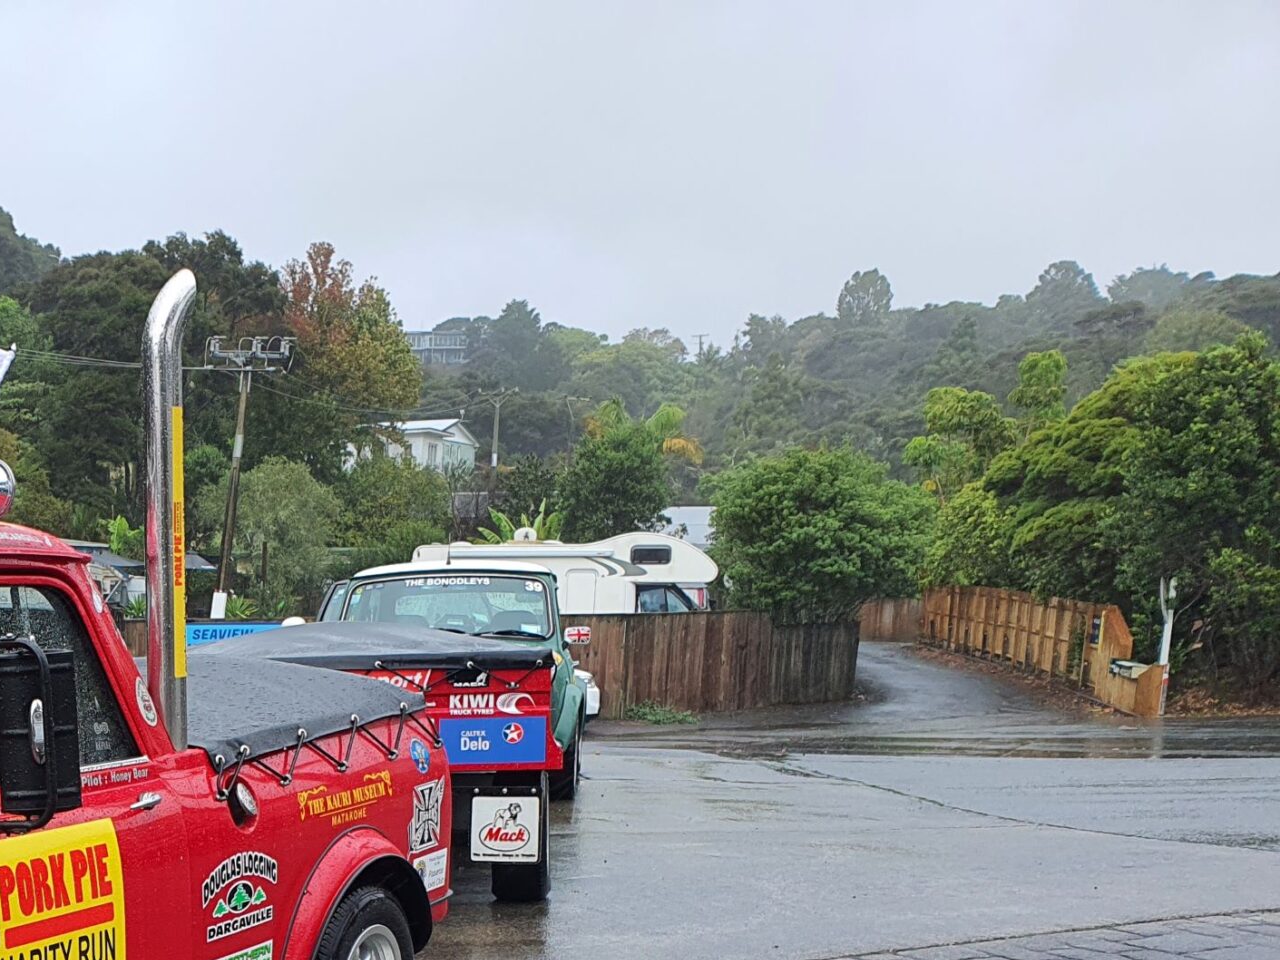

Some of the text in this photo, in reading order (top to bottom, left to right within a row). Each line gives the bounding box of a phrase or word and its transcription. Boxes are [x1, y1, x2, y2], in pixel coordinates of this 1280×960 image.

[404, 578, 425, 587] THE
[524, 581, 543, 592] 39
[449, 693, 495, 709] KIWI
[450, 708, 472, 716] TRUCK
[460, 737, 490, 751] Delo
[81, 775, 103, 788] Pilot
[110, 769, 132, 784] Honey
[132, 767, 149, 779] Bear
[308, 781, 386, 816] THE KAURI MUSEUM
[331, 807, 368, 827] MATAKOHE
[483, 827, 525, 842] Mack
[70, 843, 113, 904] PIE
[203, 852, 277, 905] DOUGLAS LOGGING
[207, 907, 273, 940] DARGAVILLE
